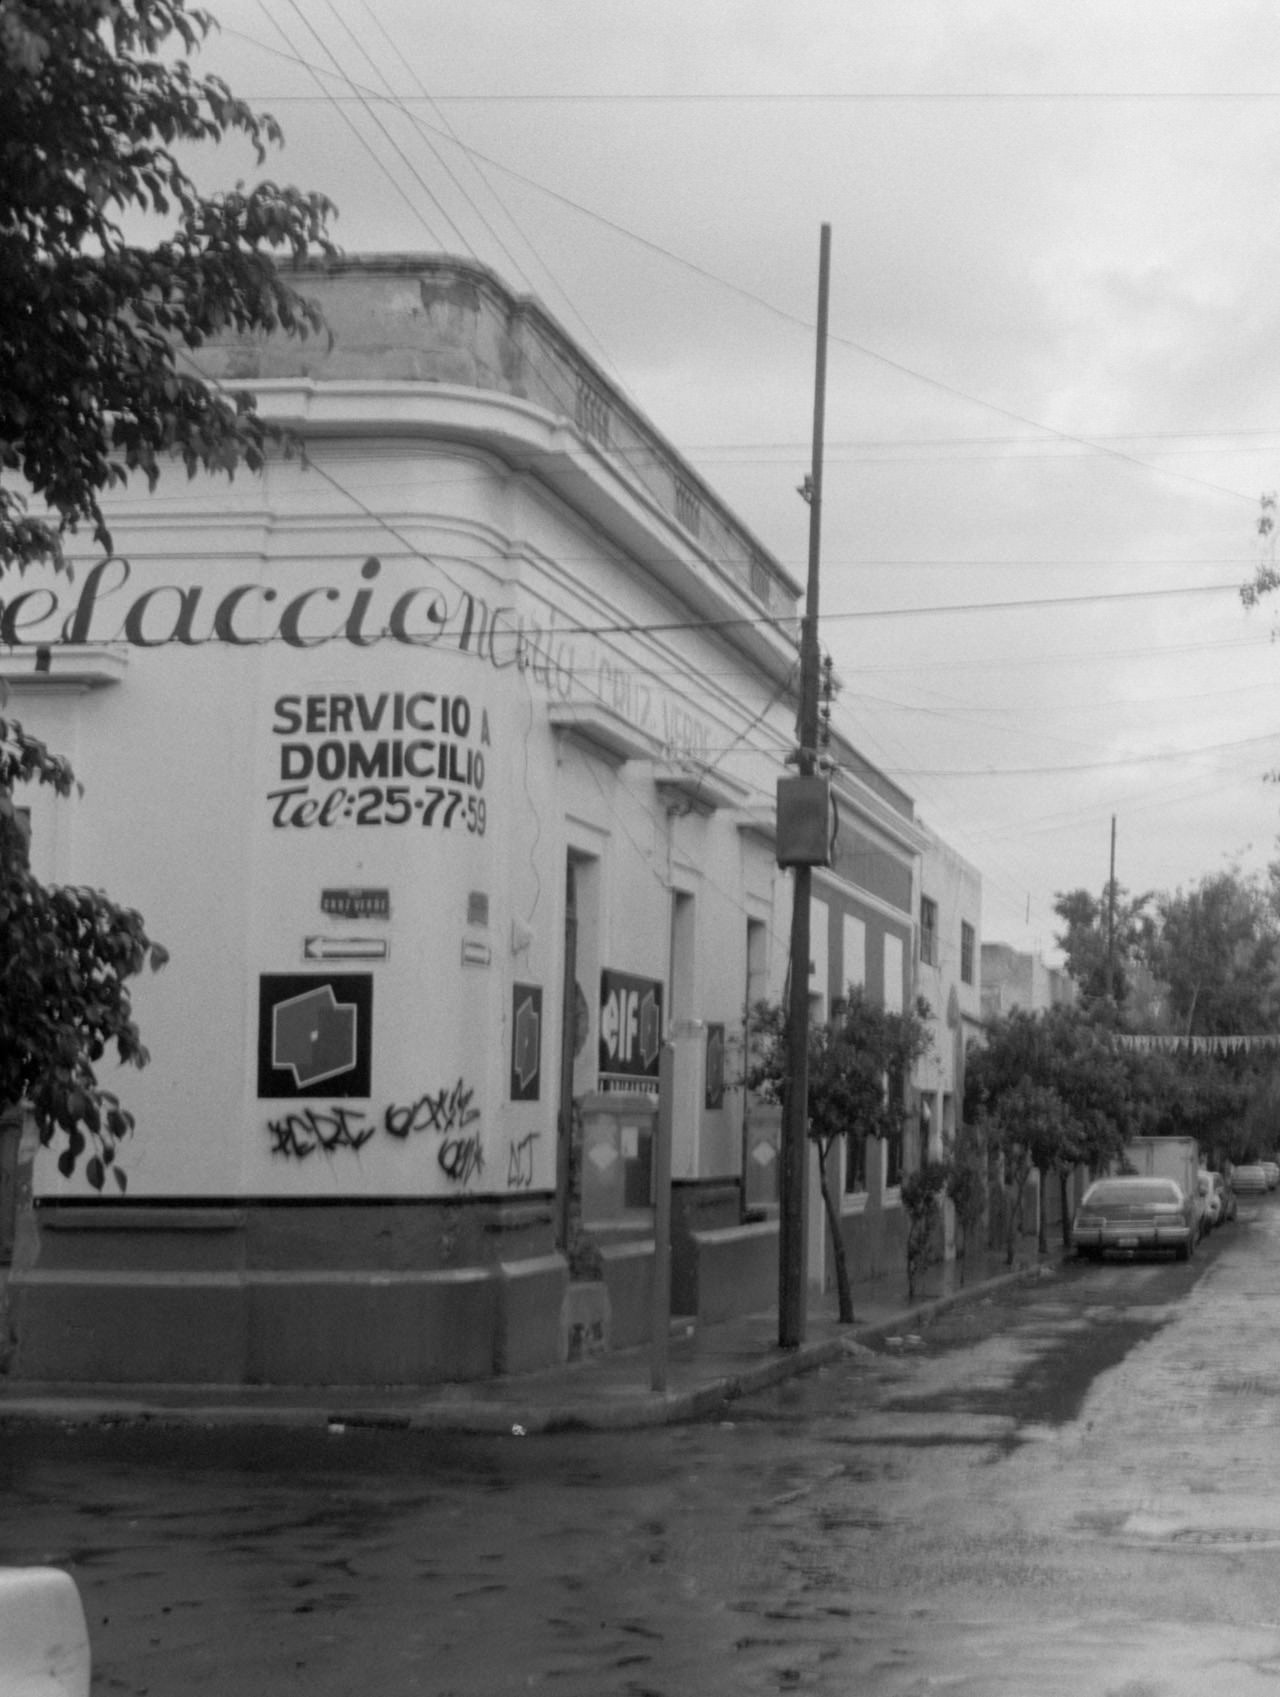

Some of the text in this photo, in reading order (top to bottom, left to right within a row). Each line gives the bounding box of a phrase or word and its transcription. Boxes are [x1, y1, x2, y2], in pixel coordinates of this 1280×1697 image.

[272, 691, 492, 747] SERVICIO A
[280, 739, 485, 791] DOMICILIO
[602, 987, 639, 1063] elf
